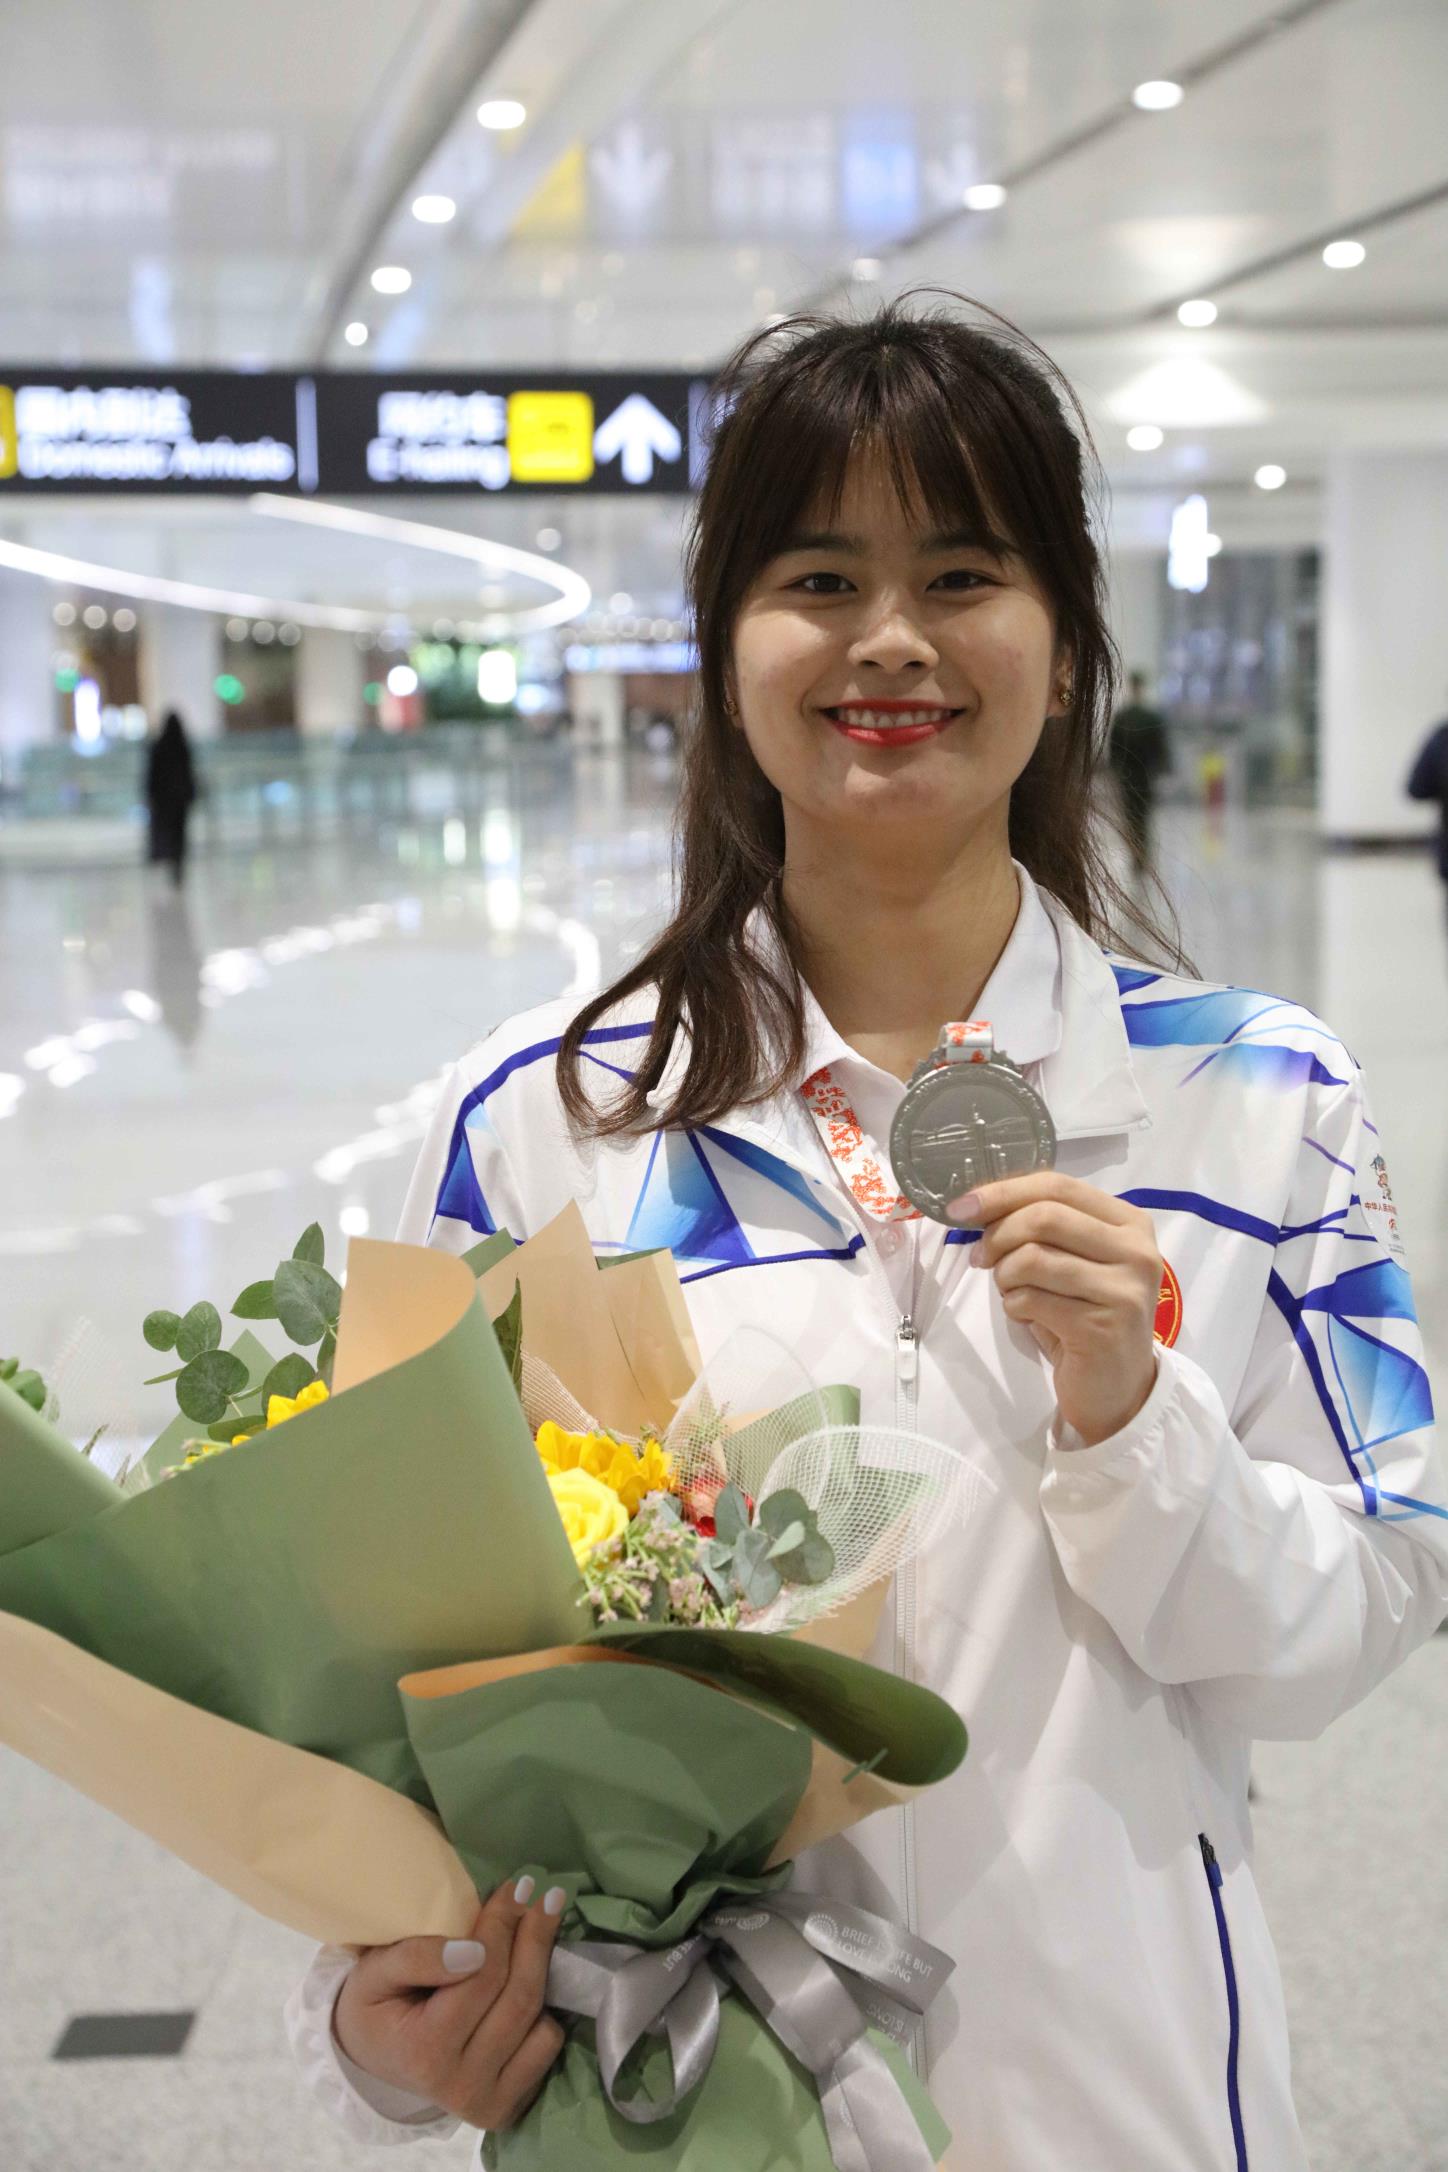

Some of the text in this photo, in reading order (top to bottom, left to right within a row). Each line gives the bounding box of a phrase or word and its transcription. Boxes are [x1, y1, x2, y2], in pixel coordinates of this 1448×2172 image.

[841, 1927, 875, 1947] BRIEF
[912, 1957, 933, 1978] BUT
[886, 1961, 912, 1984] ONG
